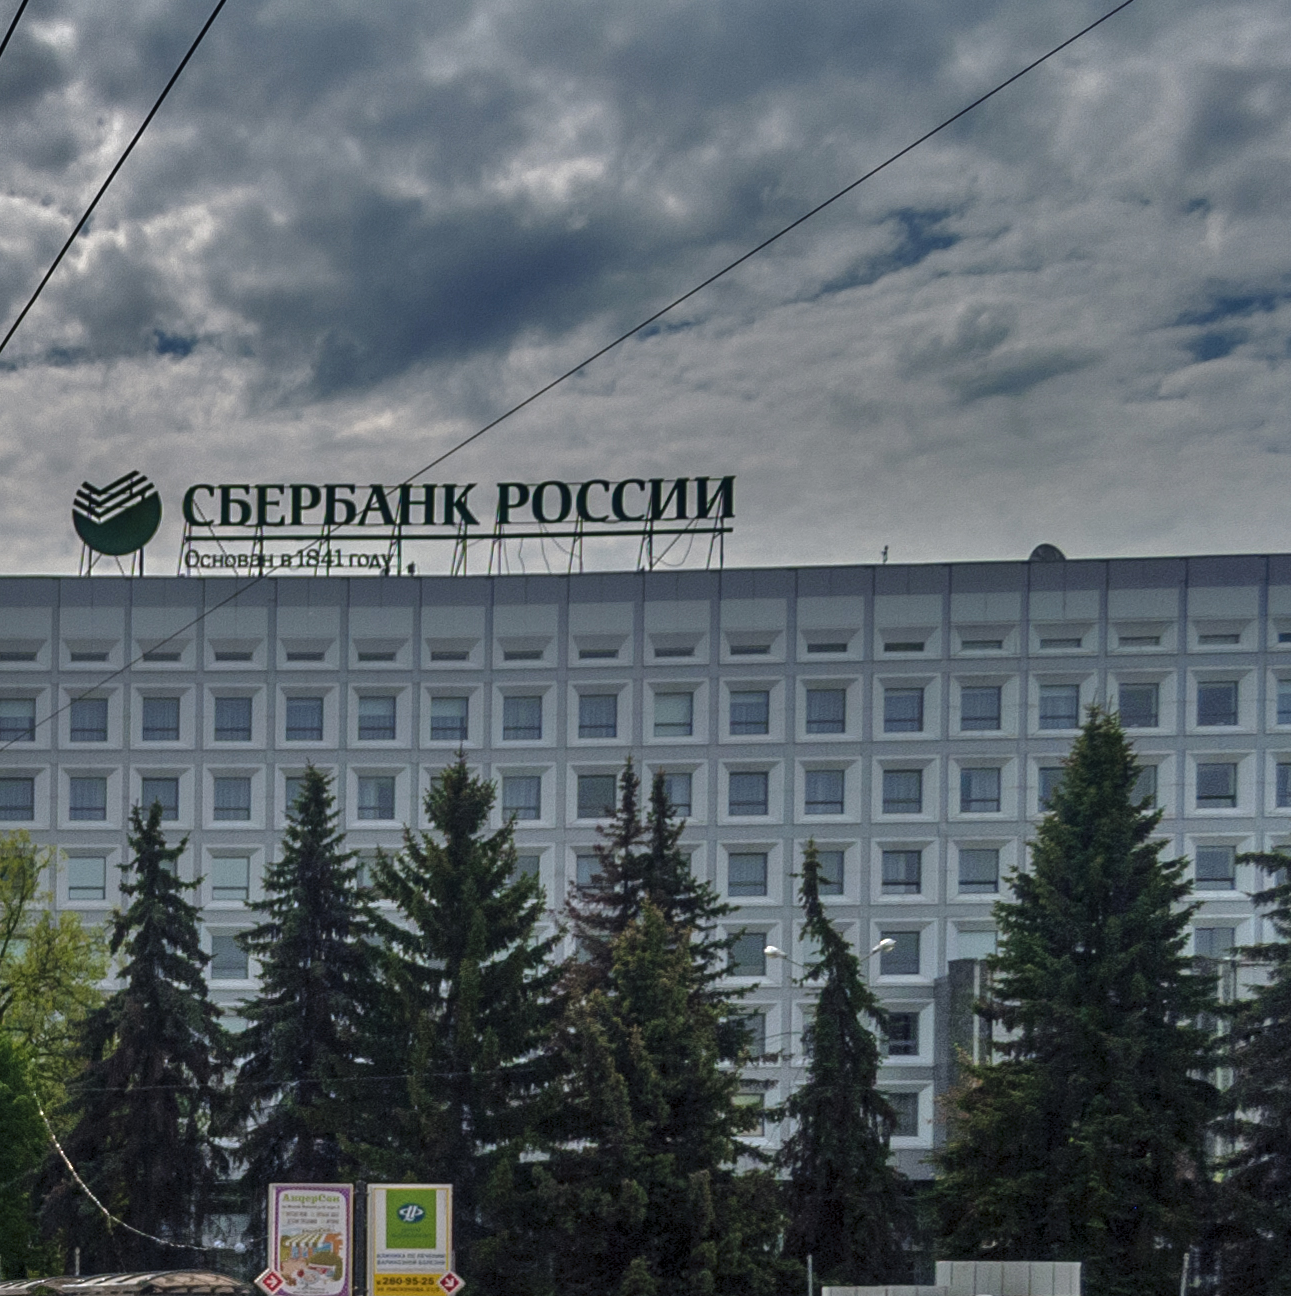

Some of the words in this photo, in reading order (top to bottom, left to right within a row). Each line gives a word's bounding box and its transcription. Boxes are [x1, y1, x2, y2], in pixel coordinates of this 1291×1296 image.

[182, 483, 480, 526] СБЕРБАНК
[496, 475, 736, 525] РОССИИ
[184, 549, 274, 568] Основан
[281, 555, 293, 568] в
[297, 549, 343, 568] 1841
[348, 554, 391, 574] году
